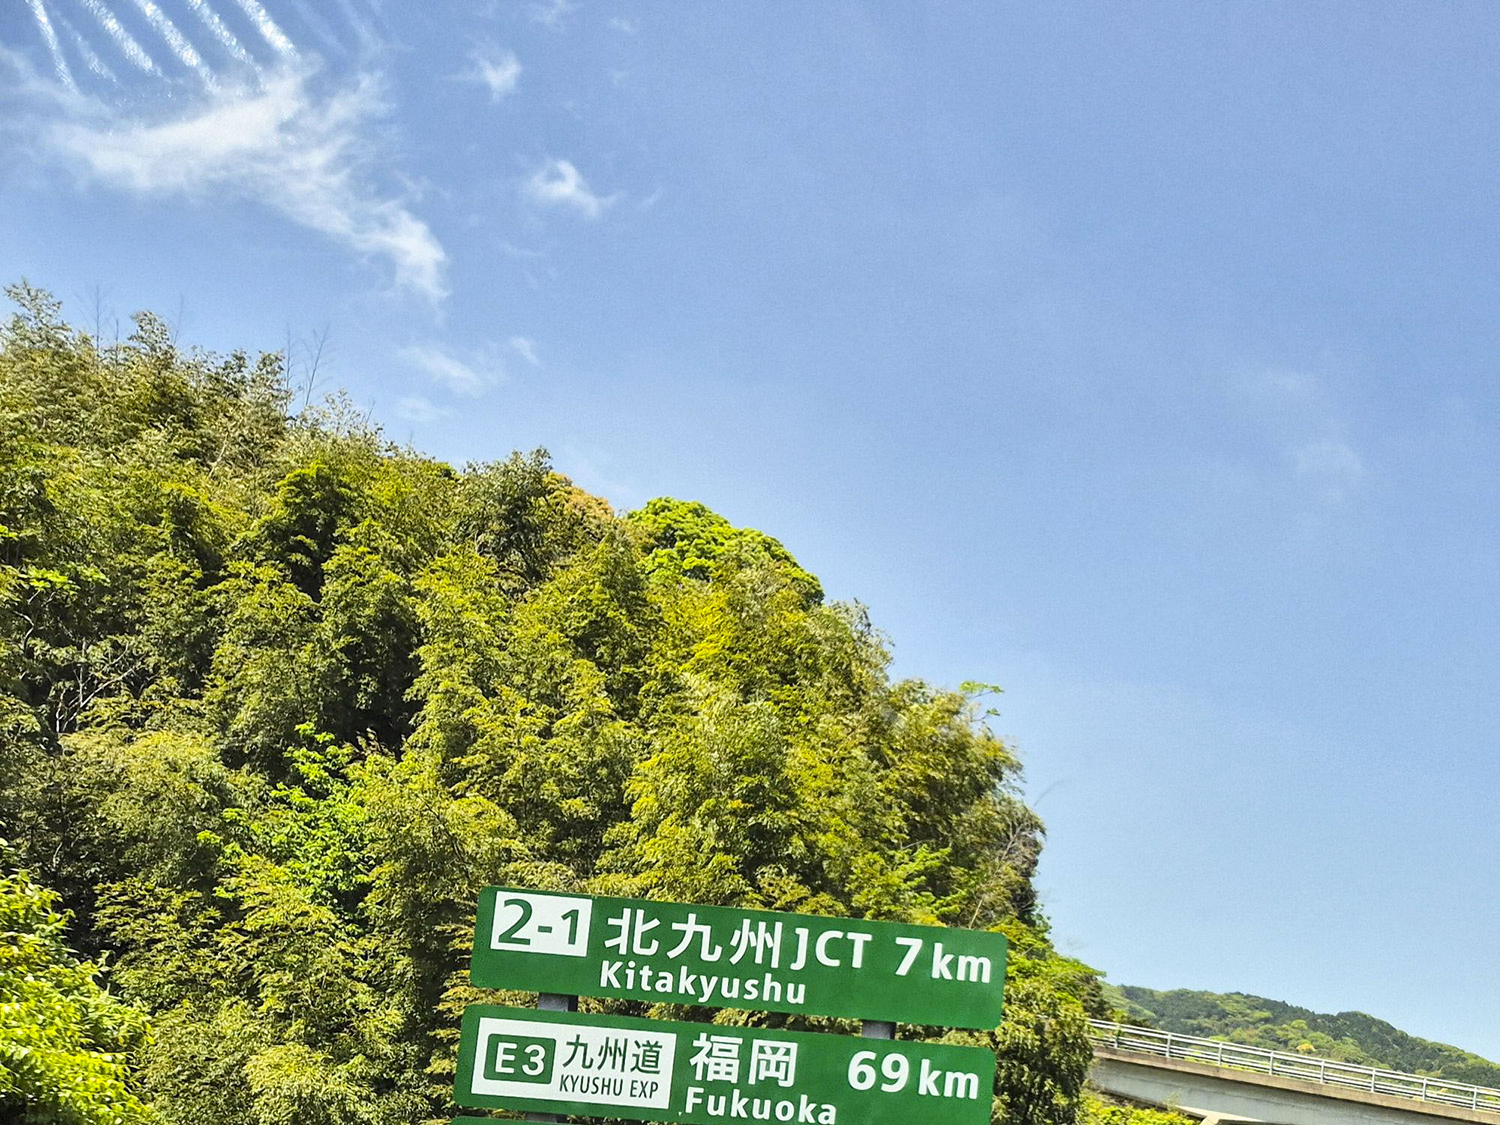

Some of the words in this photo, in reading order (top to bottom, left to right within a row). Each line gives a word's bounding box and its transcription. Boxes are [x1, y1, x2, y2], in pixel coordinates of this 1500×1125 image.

[498, 899, 579, 946] 2-1
[600, 961, 806, 1004] Kitakyushu
[495, 1042, 546, 1076] E3
[563, 1034, 663, 1075] 九州道
[690, 1033, 799, 1087] 福岡
[559, 1075, 624, 1097] KYUSHU
[630, 1080, 659, 1099] EXP
[686, 1087, 837, 1125] Fukuoka
